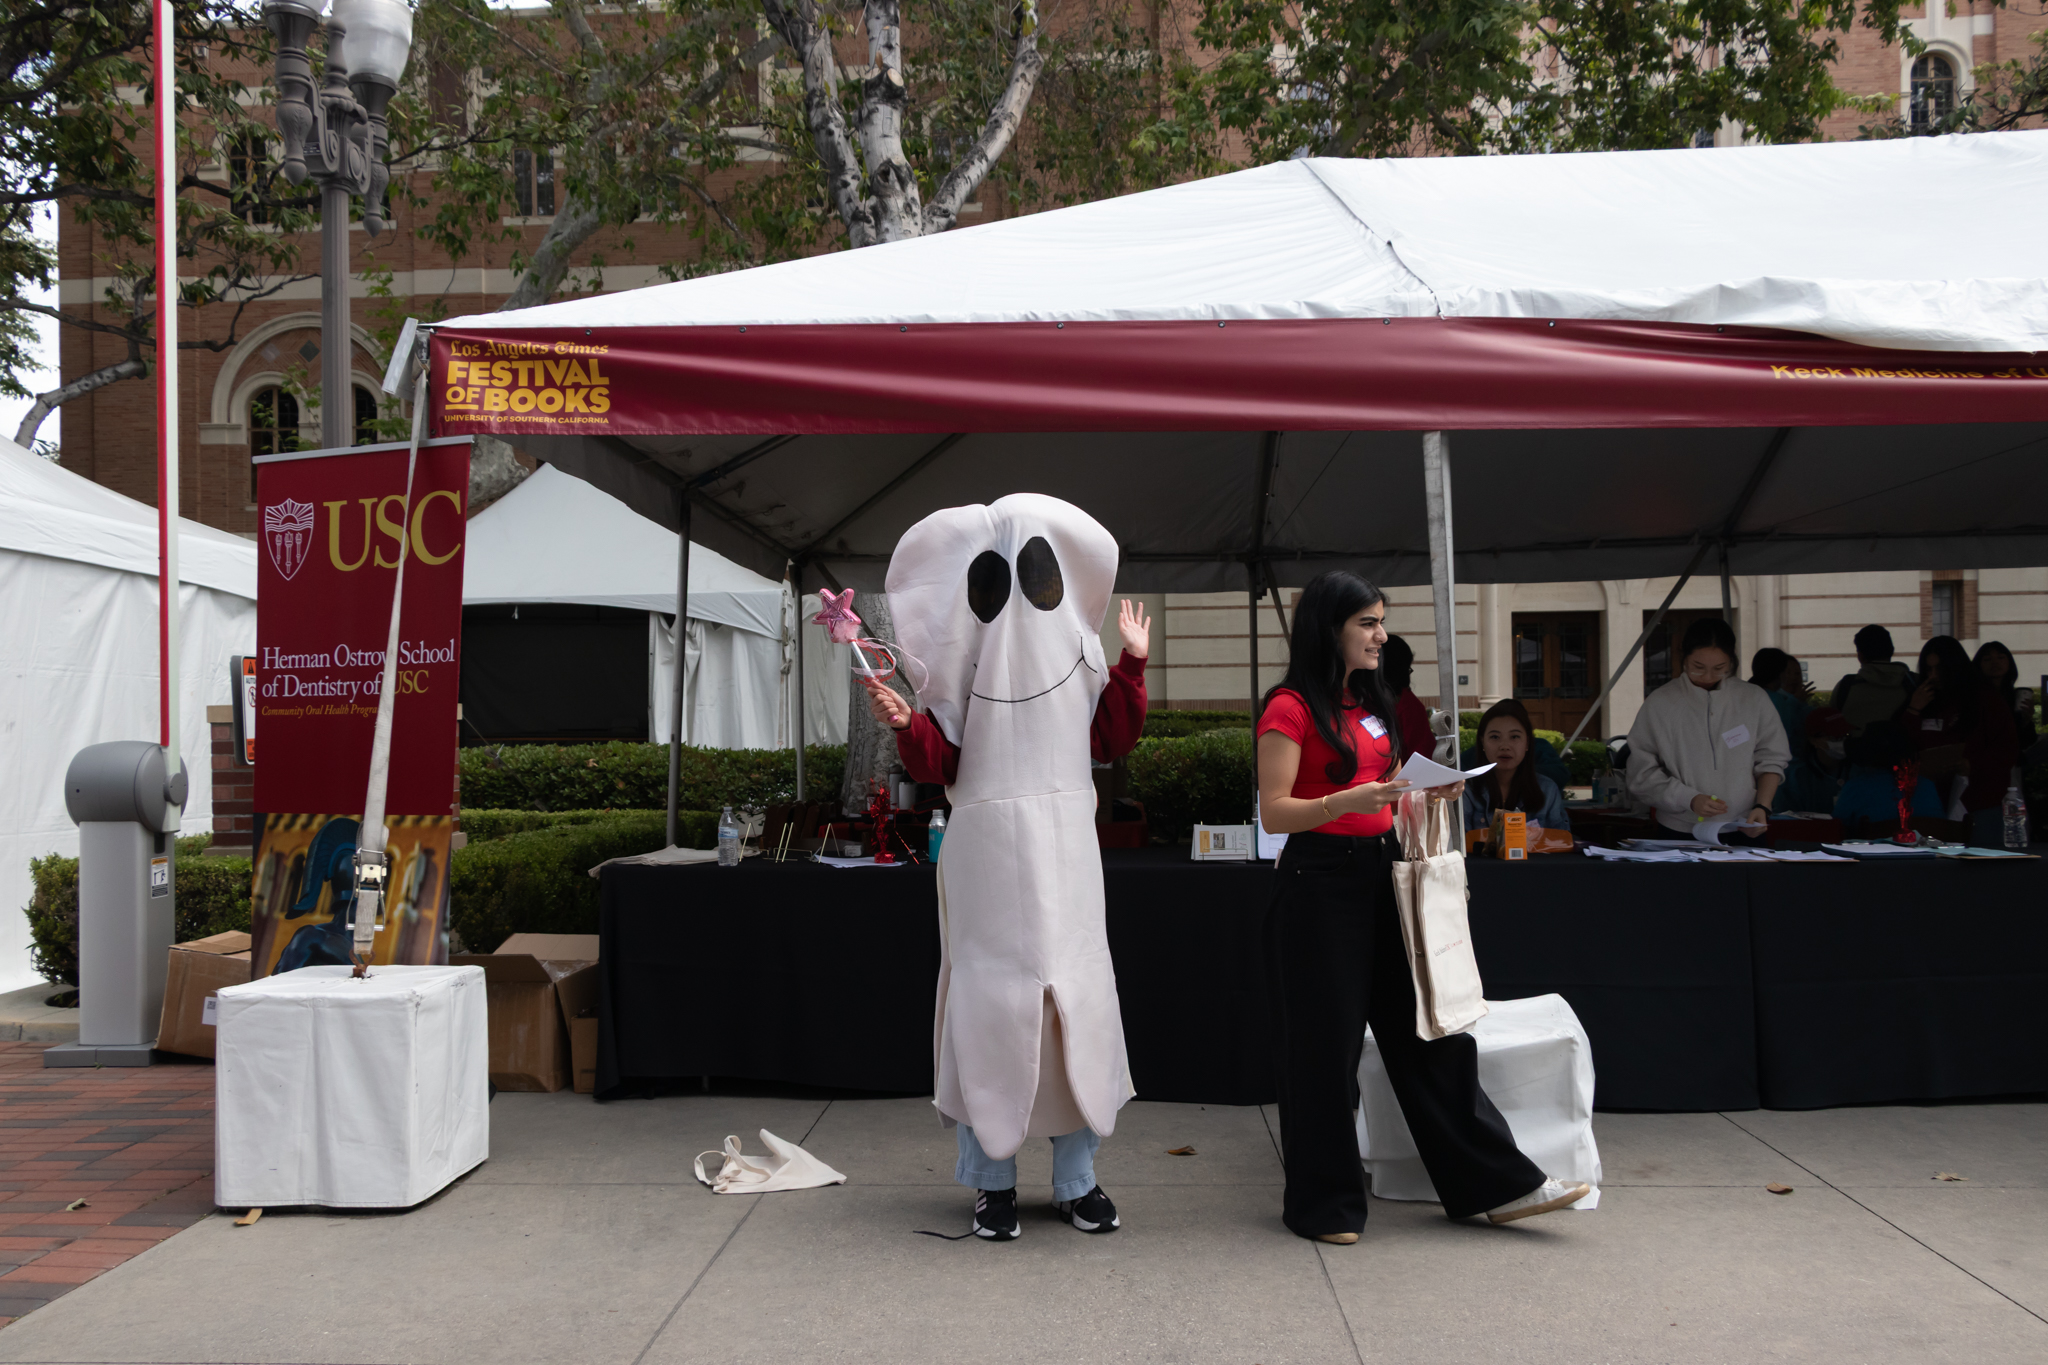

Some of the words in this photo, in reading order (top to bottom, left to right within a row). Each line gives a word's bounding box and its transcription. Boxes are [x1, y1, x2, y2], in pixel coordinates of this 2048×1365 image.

[451, 340, 481, 357] Los
[484, 339, 549, 359] Angeles
[554, 341, 609, 355] Times
[447, 358, 610, 387] FESTIVAL
[1770, 365, 1847, 379] Keck
[1850, 367, 1984, 378] Medicine
[1992, 368, 2022, 378] of
[445, 386, 480, 404] OF
[483, 386, 610, 413] BOOKS
[558, 416, 609, 424] CALIFORNIA
[323, 490, 461, 571] USC
[263, 646, 331, 669] Herman
[399, 638, 455, 665] School
[262, 675, 281, 697] of
[282, 674, 361, 703] Dentistry
[363, 671, 384, 695] of
[261, 705, 304, 719] Community
[305, 705, 322, 716] Oral
[324, 704, 349, 715] Health
[350, 703, 378, 718] Progra
